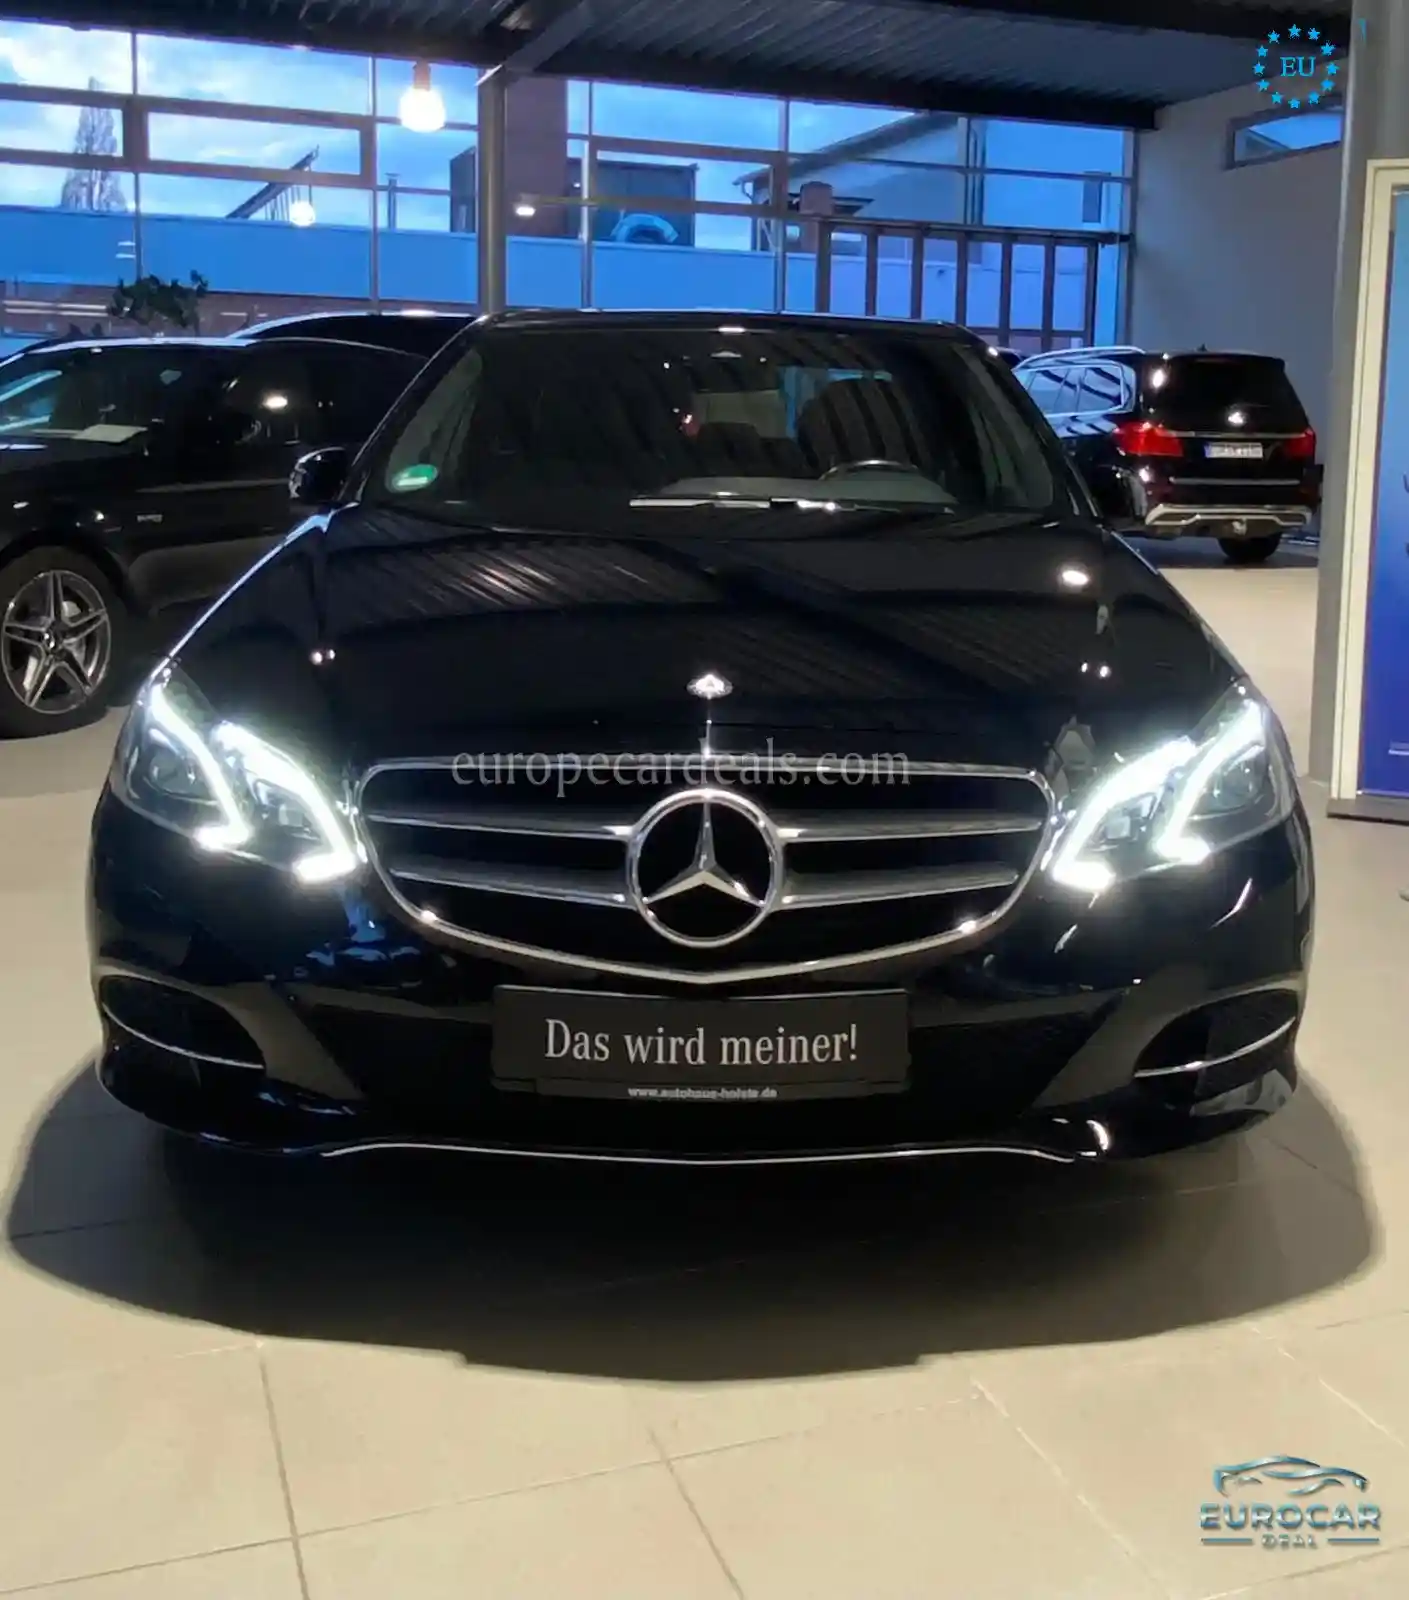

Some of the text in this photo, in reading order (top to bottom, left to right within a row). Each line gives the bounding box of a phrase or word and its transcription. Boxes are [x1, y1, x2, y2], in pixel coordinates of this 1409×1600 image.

[544, 1019, 858, 1065] Das wird meiner!
